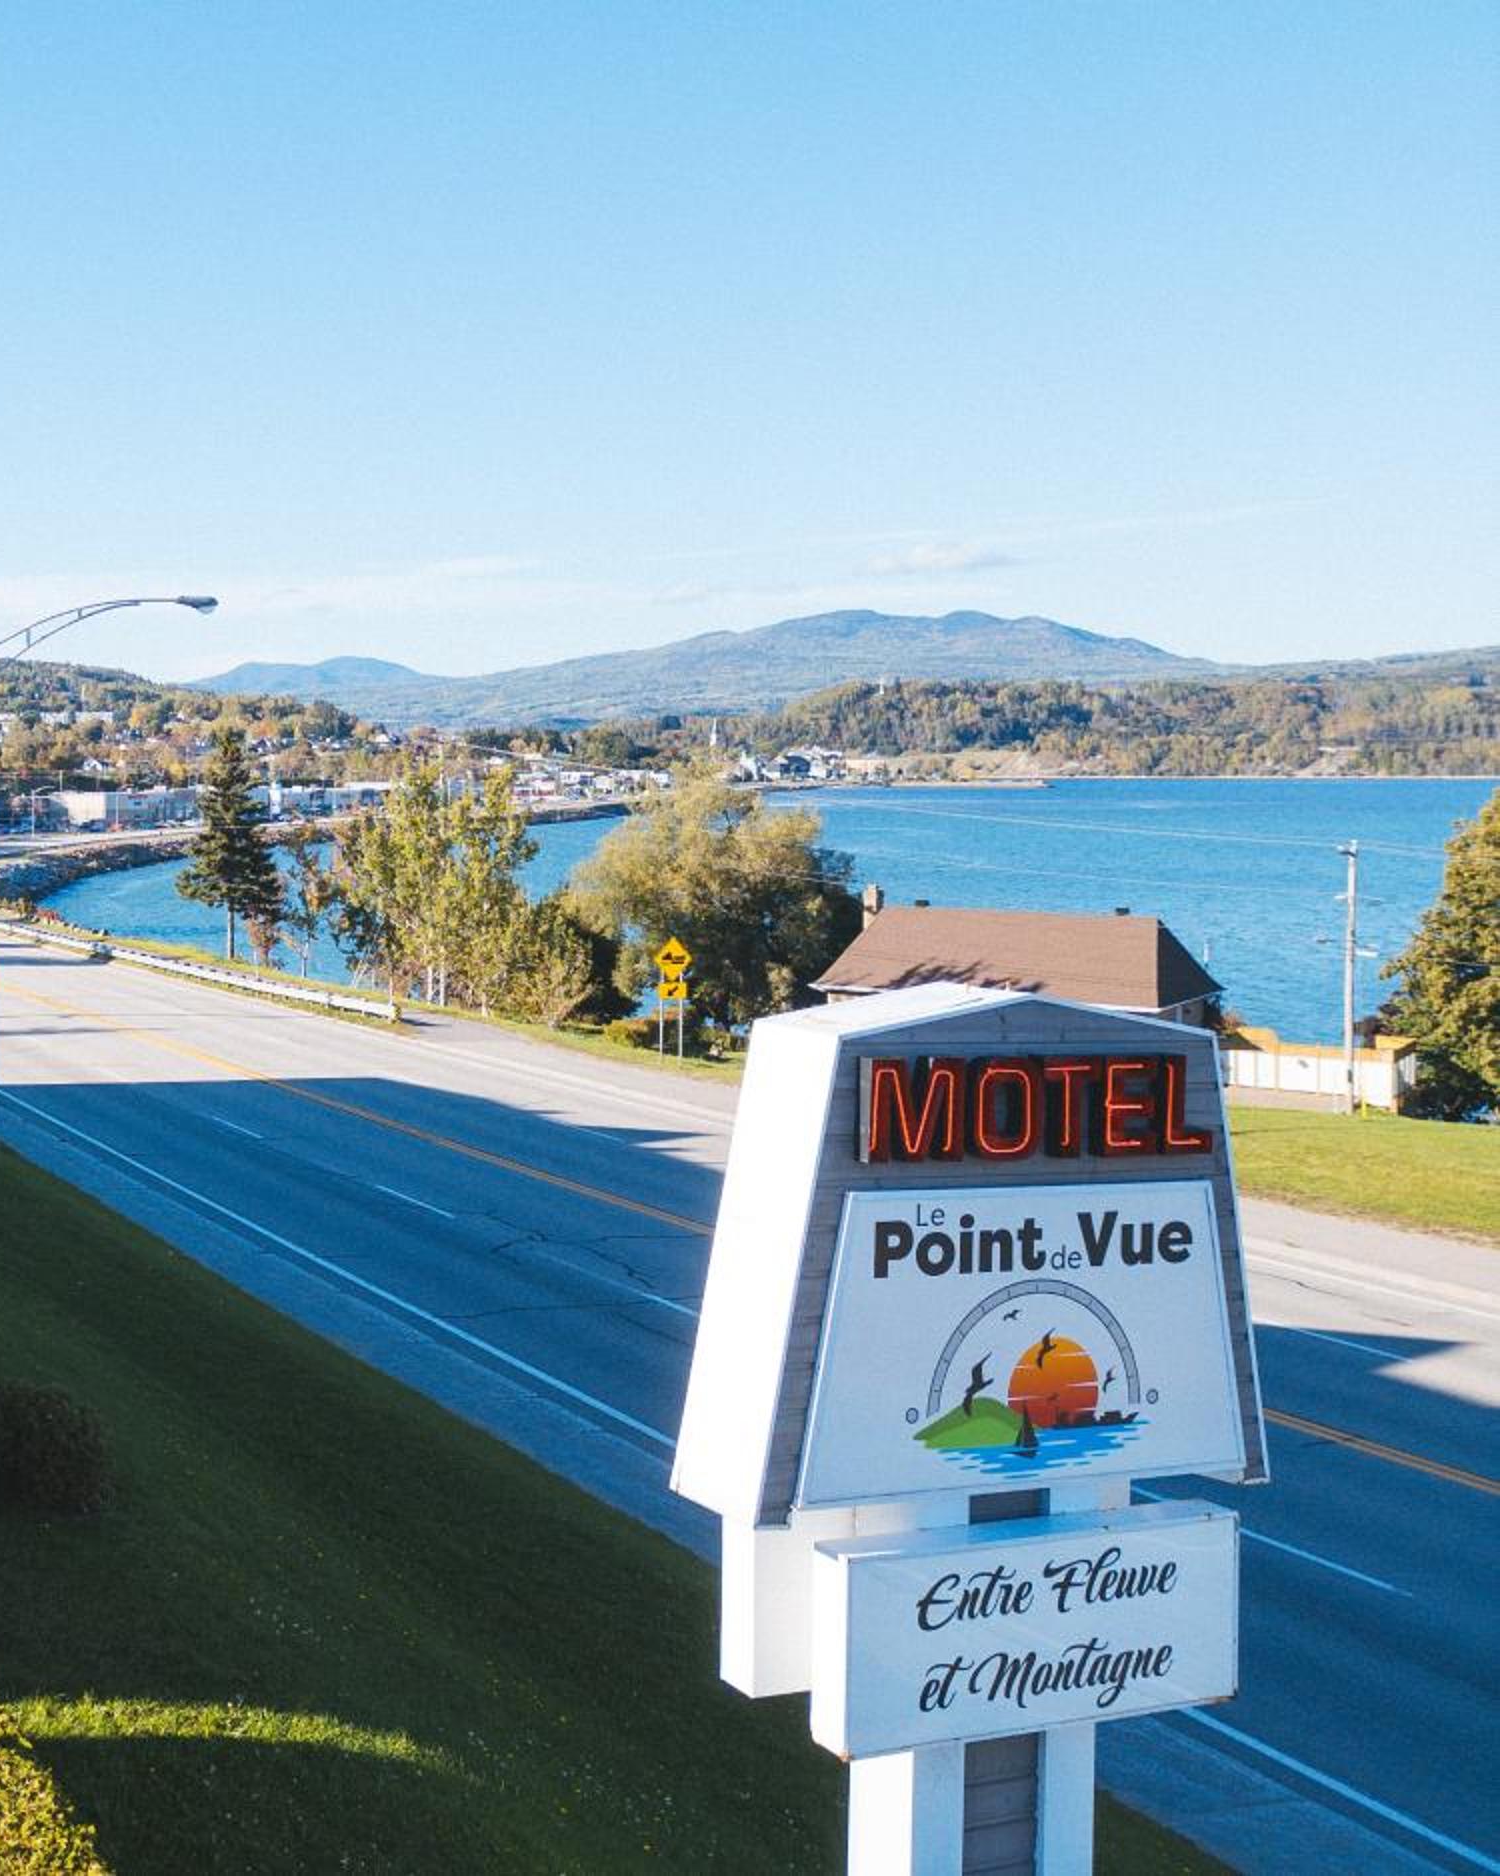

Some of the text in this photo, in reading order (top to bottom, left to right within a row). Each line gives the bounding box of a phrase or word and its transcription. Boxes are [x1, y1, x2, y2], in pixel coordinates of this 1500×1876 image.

[858, 1056, 1212, 1163] MOTEL
[874, 1204, 1193, 1278] Le Point de Vue
[916, 1547, 1178, 1631] Entre Fleuve
[919, 1638, 1173, 1712] et Montagne
